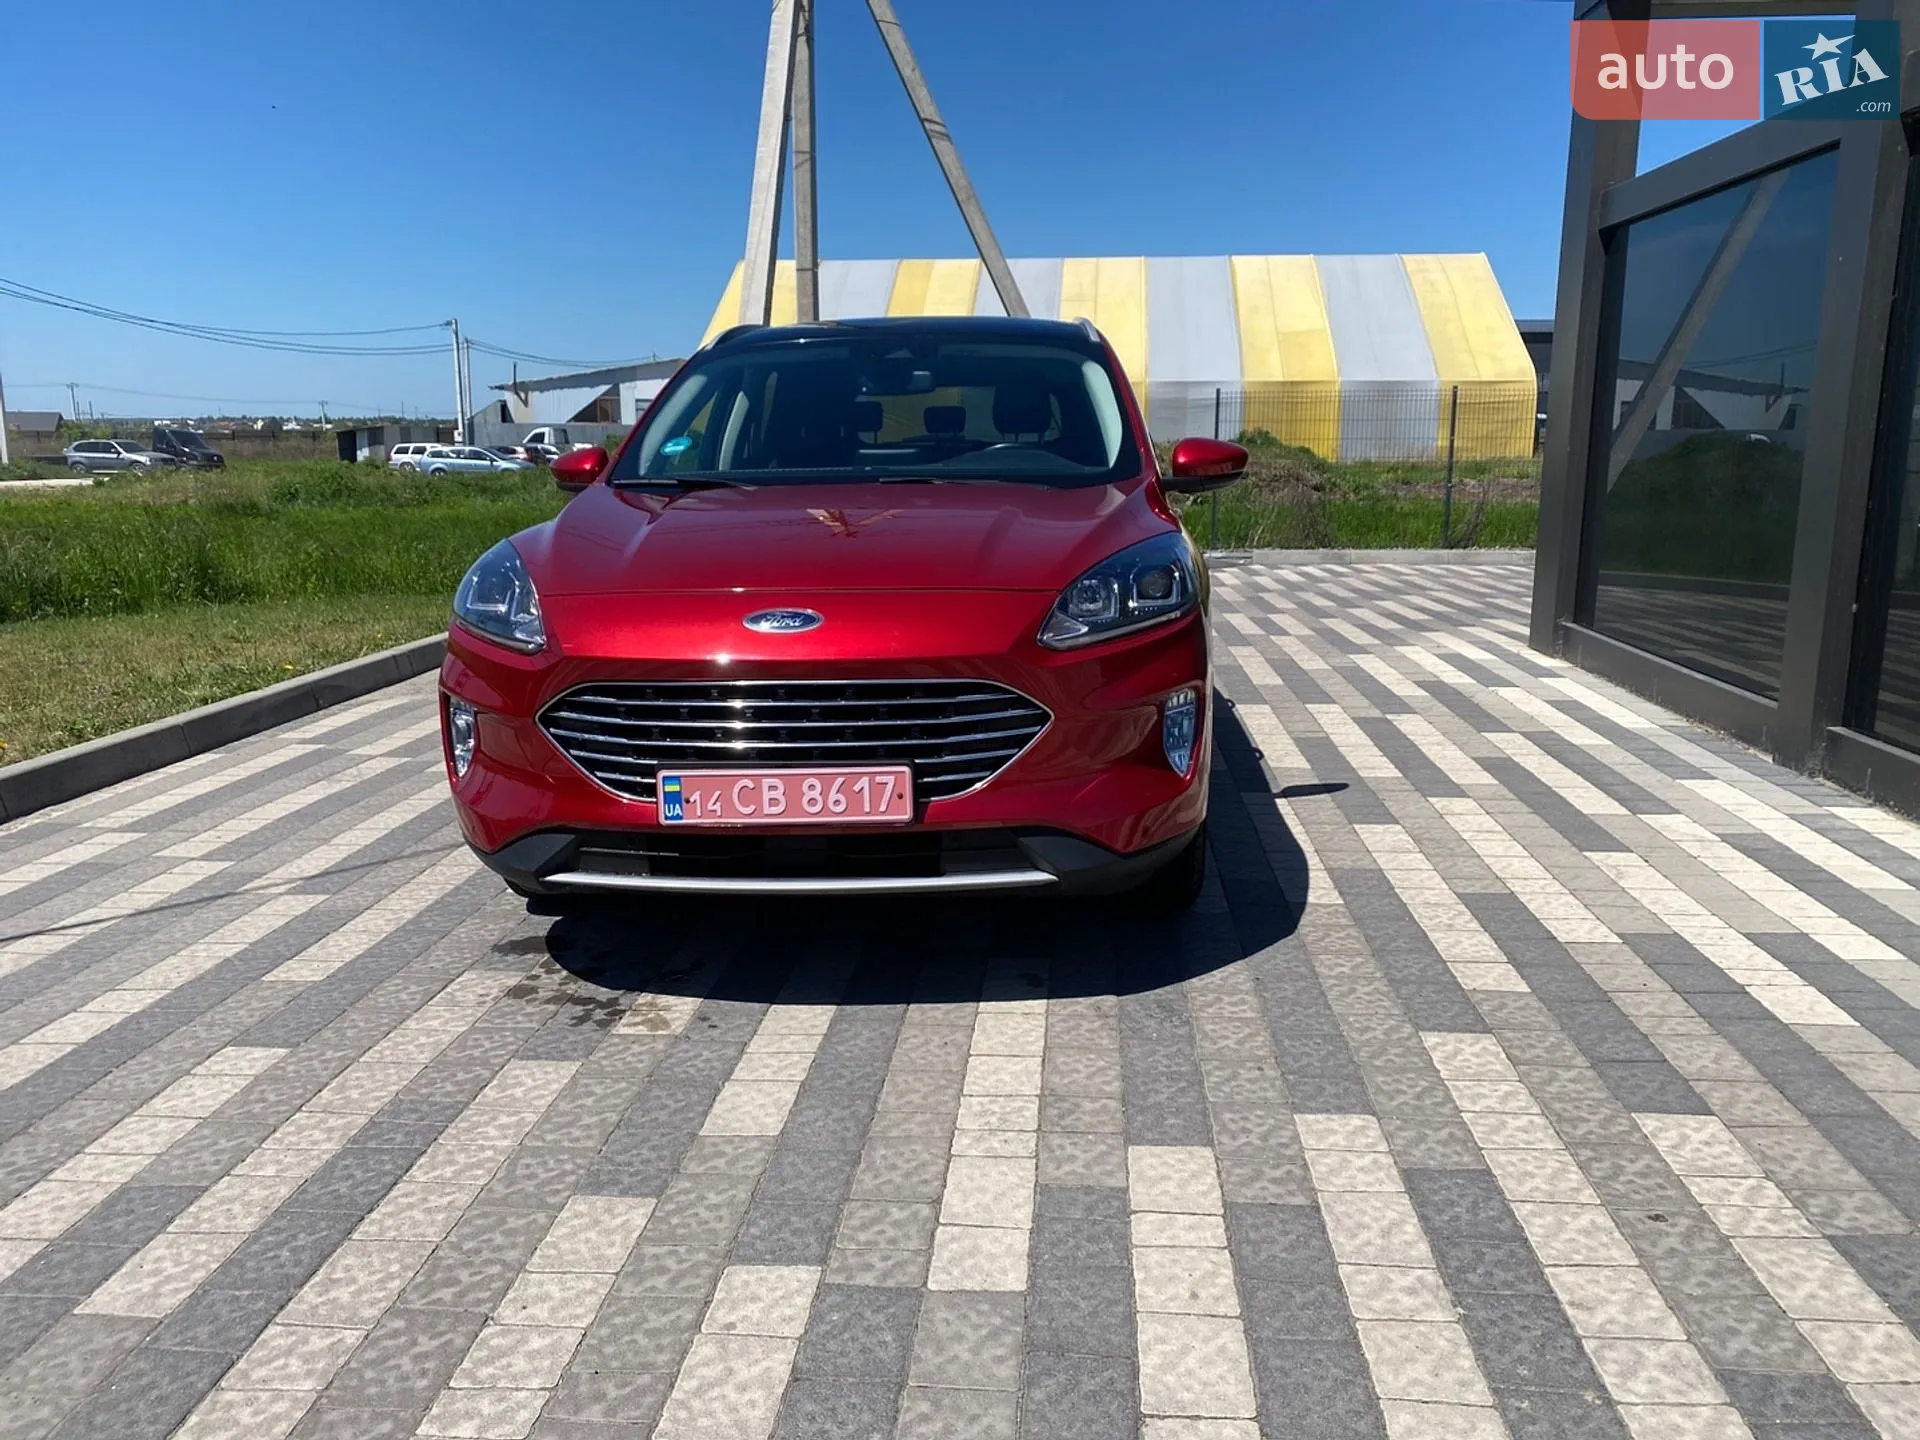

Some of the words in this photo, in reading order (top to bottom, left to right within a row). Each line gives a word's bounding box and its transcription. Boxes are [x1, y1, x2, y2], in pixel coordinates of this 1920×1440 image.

[688, 790, 723, 816] 14
[731, 778, 788, 815] CB
[801, 776, 896, 814] 8617
[664, 804, 683, 817] UA
